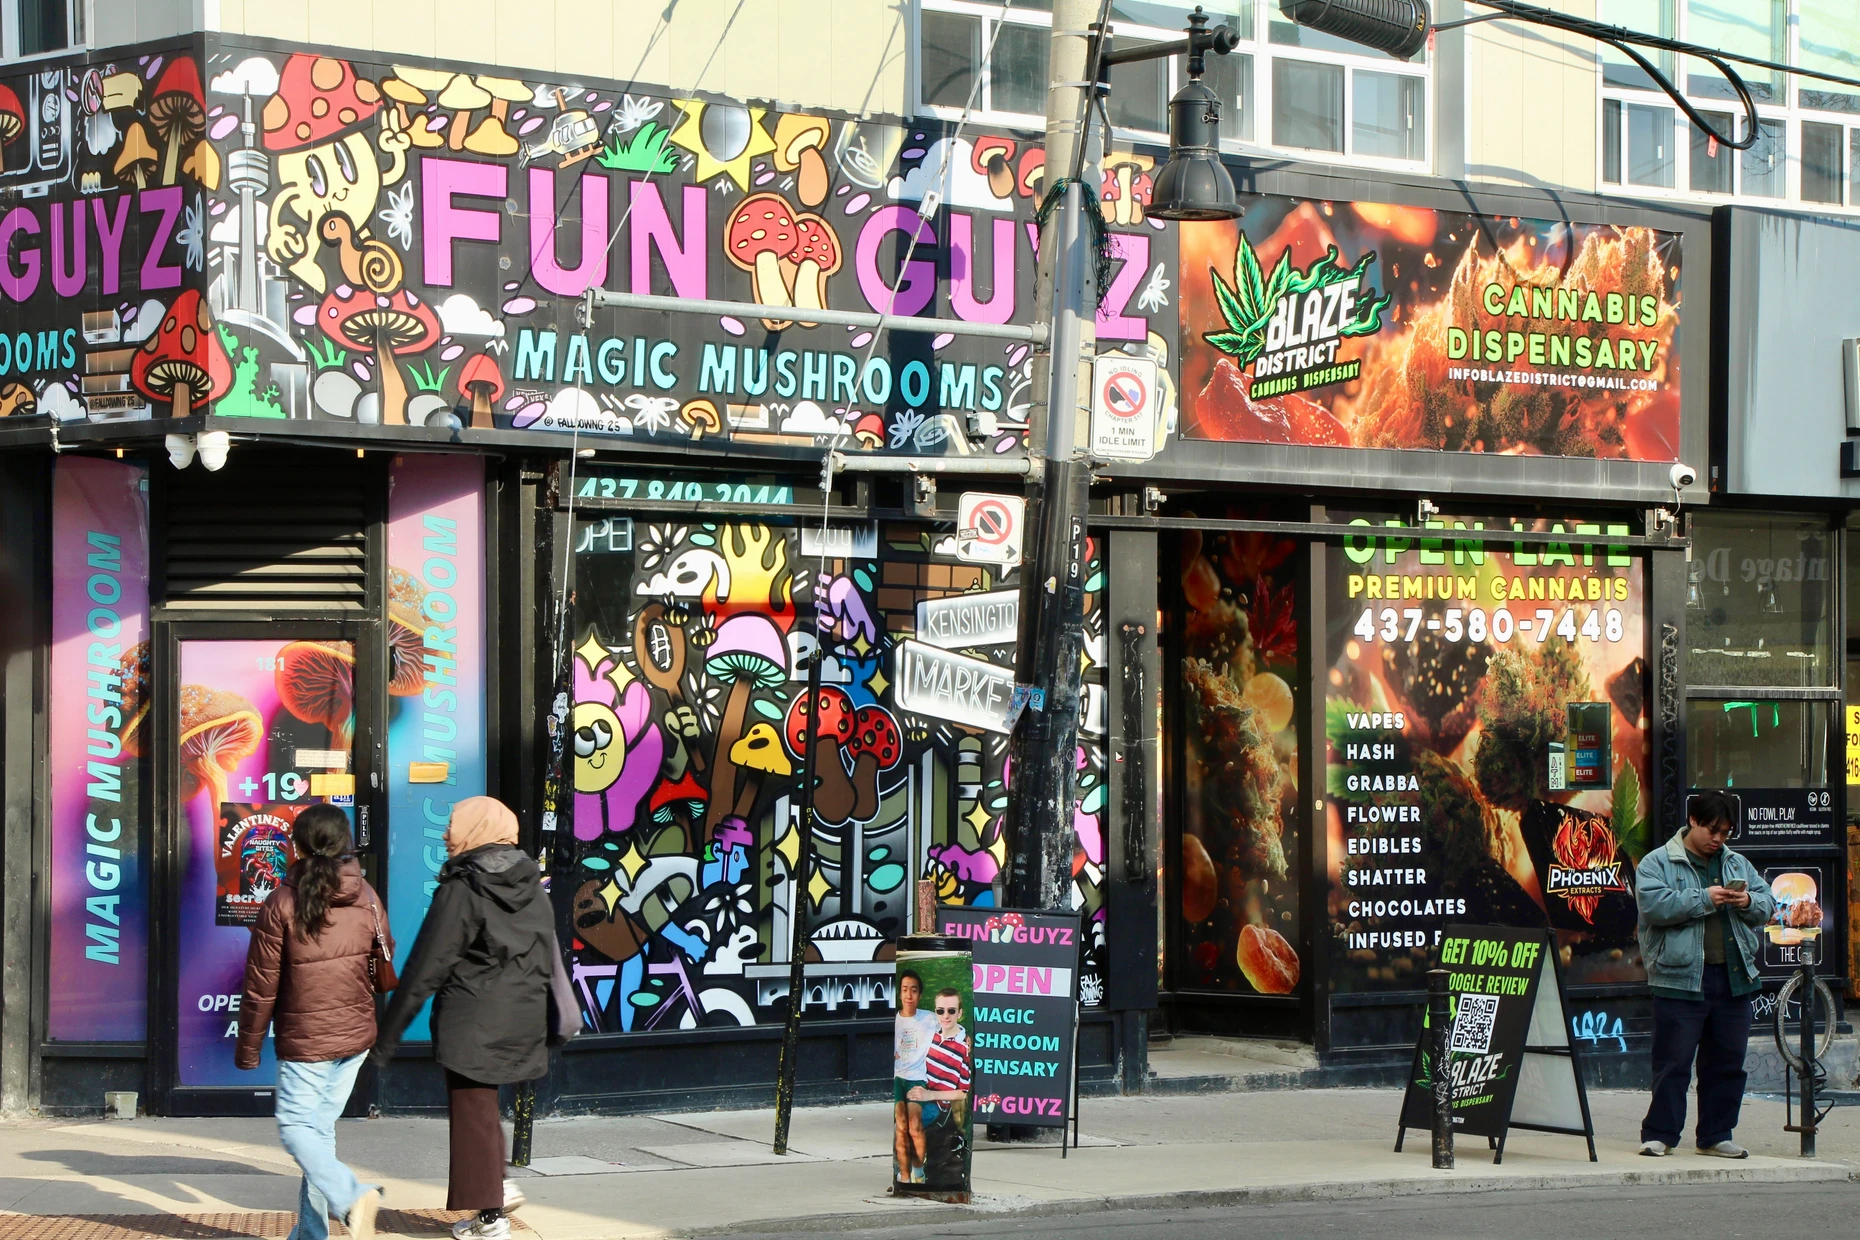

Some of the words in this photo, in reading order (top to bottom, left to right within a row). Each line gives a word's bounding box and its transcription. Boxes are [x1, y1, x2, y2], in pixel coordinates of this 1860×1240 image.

[0, 187, 183, 303] GUYZ
[421, 157, 708, 300] FUN
[855, 205, 1150, 341] GUZ
[1266, 275, 1360, 352] BLAZE
[1483, 283, 1658, 327] CANNABIS
[1255, 339, 1340, 378] DISTRICT
[1448, 327, 1658, 372] DISPENSARY
[514, 331, 679, 390] MAGIC
[700, 343, 1003, 412] MUSHROOMS
[1108, 367, 1118, 375] NO
[1120, 366, 1143, 378] IDLING
[1251, 376, 1297, 399] CANNABIS
[1303, 362, 1360, 388] DISPENSARY
[1448, 367, 1658, 392] INFOBLAZEDISTRICT@GMAIL.COM
[1105, 410, 1133, 424] CHAPTER
[1099, 436, 1120, 445] IDLE
[1122, 437, 1146, 446] LIMIT
[1119, 427, 1135, 435] MIN
[1344, 518, 1485, 565] OPEN
[1513, 523, 1632, 567] LATE
[1348, 574, 1477, 600] PREMIUM
[1490, 576, 1629, 601] CANNABIS
[927, 602, 1019, 640] KENSINGTO
[1354, 607, 1624, 643] 437-580-7448
[86, 530, 122, 803] MUSHROOM
[256, 656, 285, 671] 181
[1346, 712, 1405, 730] VAPES
[1346, 743, 1395, 760] HASH
[239, 772, 303, 801] +19
[1346, 775, 1420, 791] GRABBA
[1347, 806, 1421, 823] FLOWER
[1748, 808, 1758, 821] NO
[1760, 807, 1779, 821] FOWL
[1779, 807, 1796, 821] PLAY
[221, 813, 291, 859] VALENTINE'S
[249, 839, 282, 847] NAUGHTY
[1347, 837, 1422, 854] EDIBLES
[1348, 868, 1426, 886] SHATTER
[1550, 867, 1618, 888] PHOENIX
[85, 811, 122, 965] MAGIC
[1570, 887, 1602, 895] EXTRACTS
[225, 893, 266, 904] secre
[1348, 898, 1467, 917] CHOCOLATES
[945, 922, 989, 942] FUN
[1013, 926, 1074, 945] GUYZ
[1349, 930, 1426, 949] INFUSED
[1441, 937, 1471, 964] GET
[1471, 939, 1508, 968] 10%
[1511, 942, 1540, 969] OFF
[1780, 946, 1795, 962] THE
[1449, 973, 1483, 993] OOGLE
[1485, 976, 1529, 996] REVIEW
[198, 994, 243, 1012] OPE
[974, 1007, 1035, 1025] MAGIC
[975, 1033, 1060, 1052] SHROOM
[975, 1059, 1060, 1078] PENSARY
[1451, 1053, 1503, 1088] BLAZE
[1452, 1082, 1486, 1099] STRICT
[1001, 1096, 1063, 1117] GUYZ
